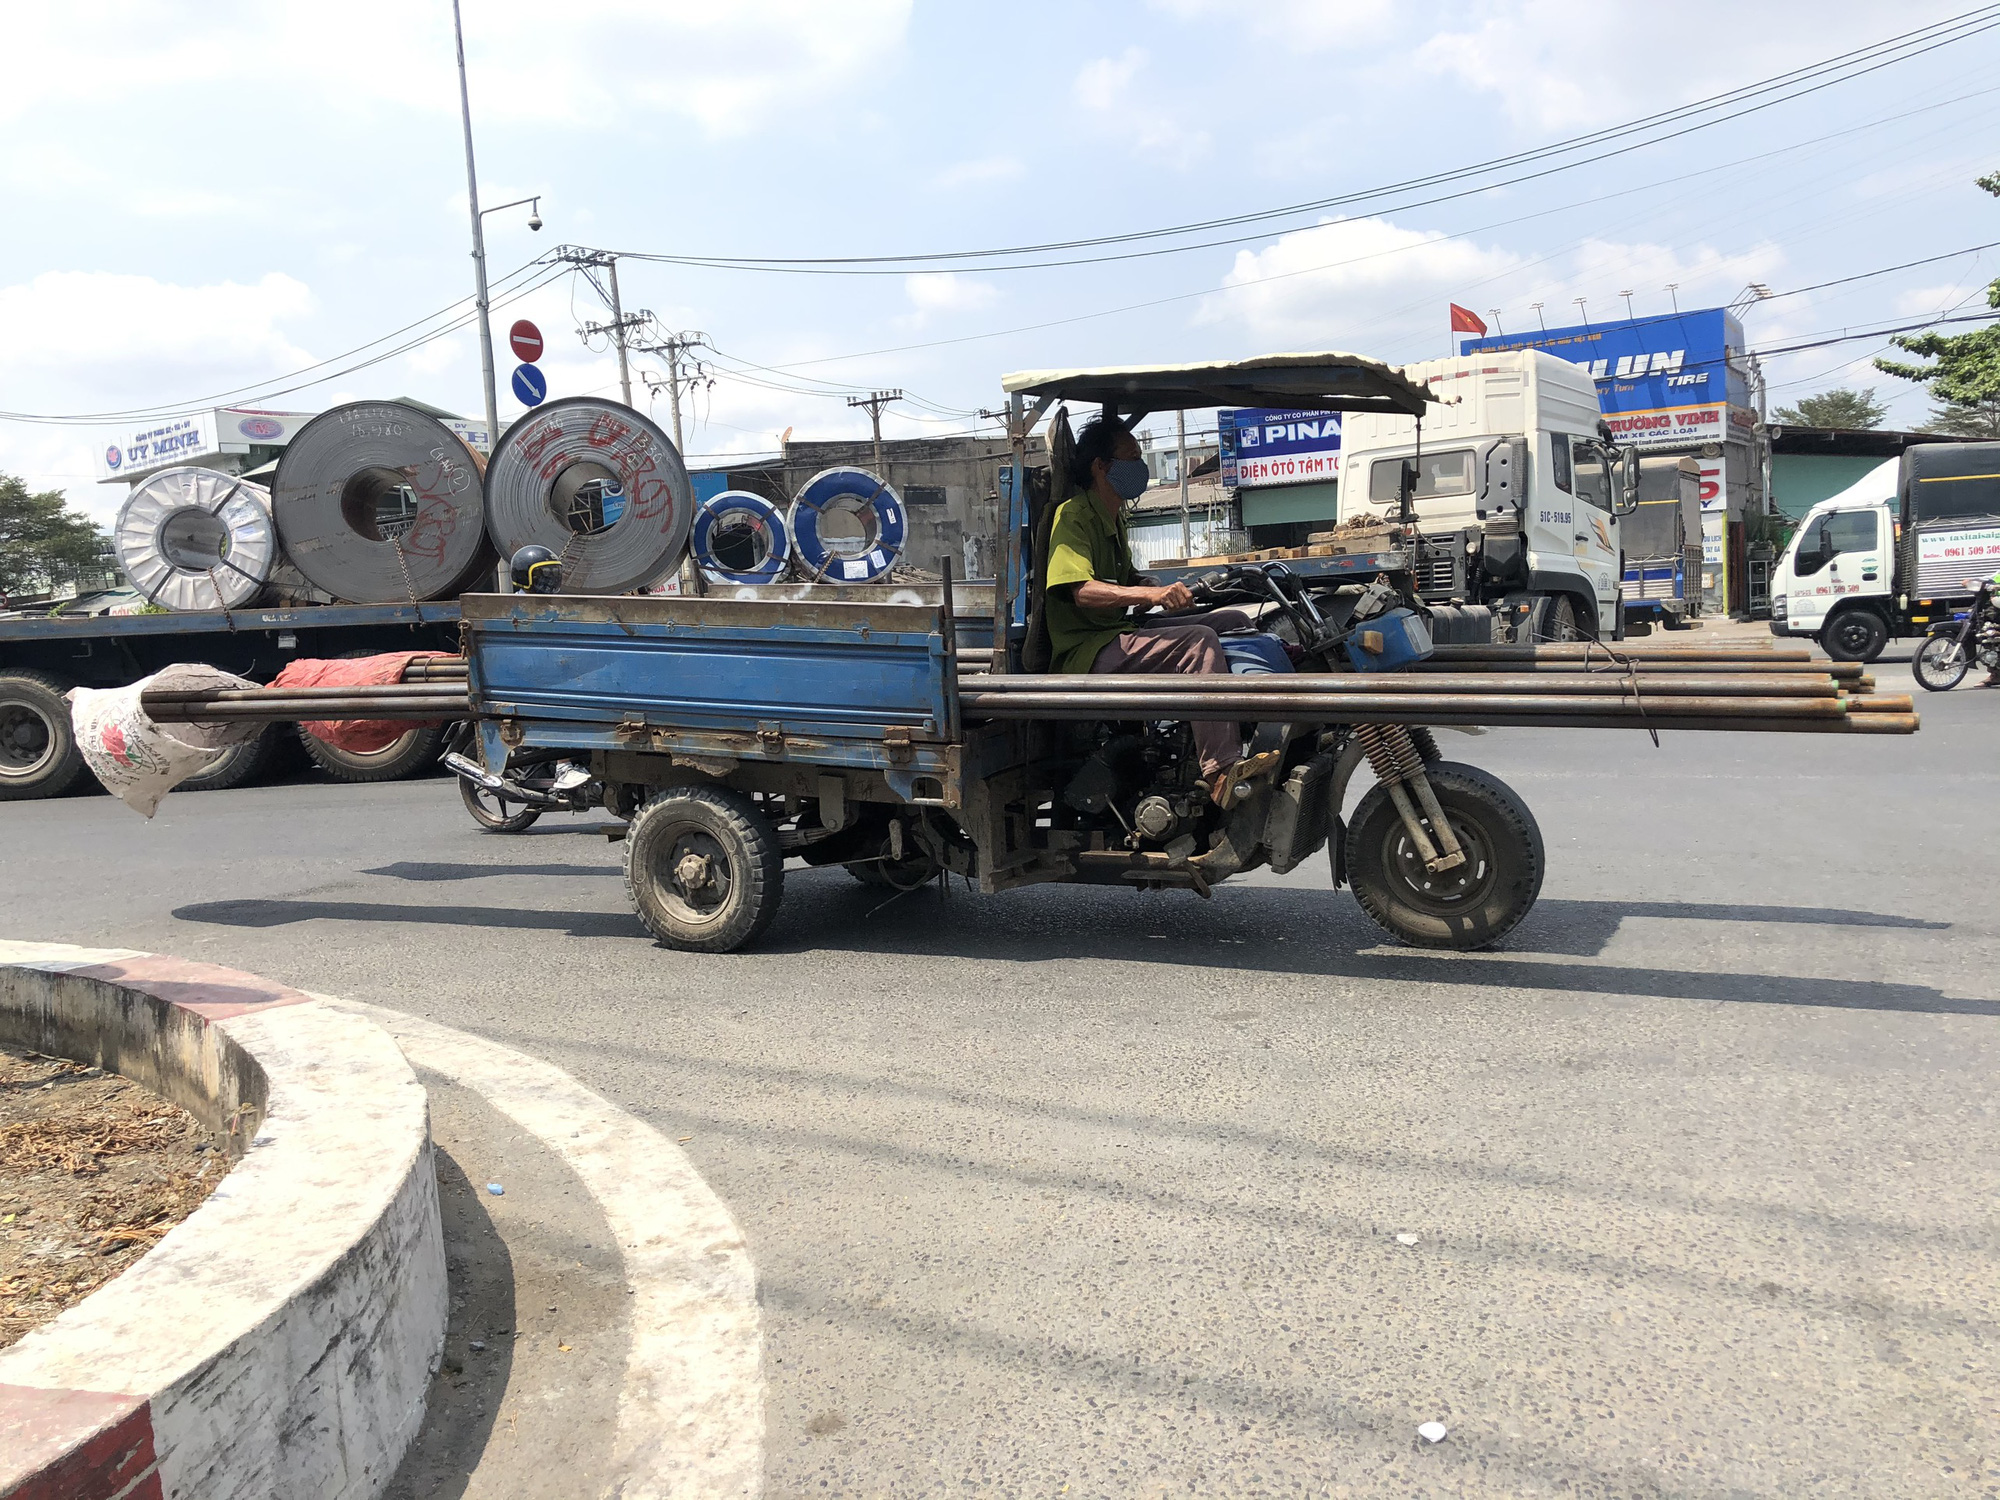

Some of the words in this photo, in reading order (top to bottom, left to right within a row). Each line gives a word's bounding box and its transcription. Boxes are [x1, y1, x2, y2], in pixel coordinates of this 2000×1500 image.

[1667, 372, 1709, 387] TIRE
[1614, 384, 1634, 392] Turn
[1264, 413, 1282, 422] CÔNG
[1284, 412, 1292, 420] TY
[1675, 410, 1720, 426] VINH
[1649, 428, 1669, 437] CÁC
[1673, 426, 1698, 436] LOẠI
[127, 444, 149, 462] UY
[152, 430, 200, 456] MINH
[1241, 462, 1268, 481] ĐIỆN
[1271, 458, 1295, 476] ÔTÔ
[1298, 456, 1323, 474] TÂM
[1540, 511, 1572, 524] 51C-519.95
[1944, 548, 1964, 557] 0961
[1968, 546, 1984, 556] 509
[668, 582, 677, 592] XE
[1816, 586, 1832, 594] 0961
[1834, 586, 1846, 594] 509
[1848, 584, 1860, 592] 509
